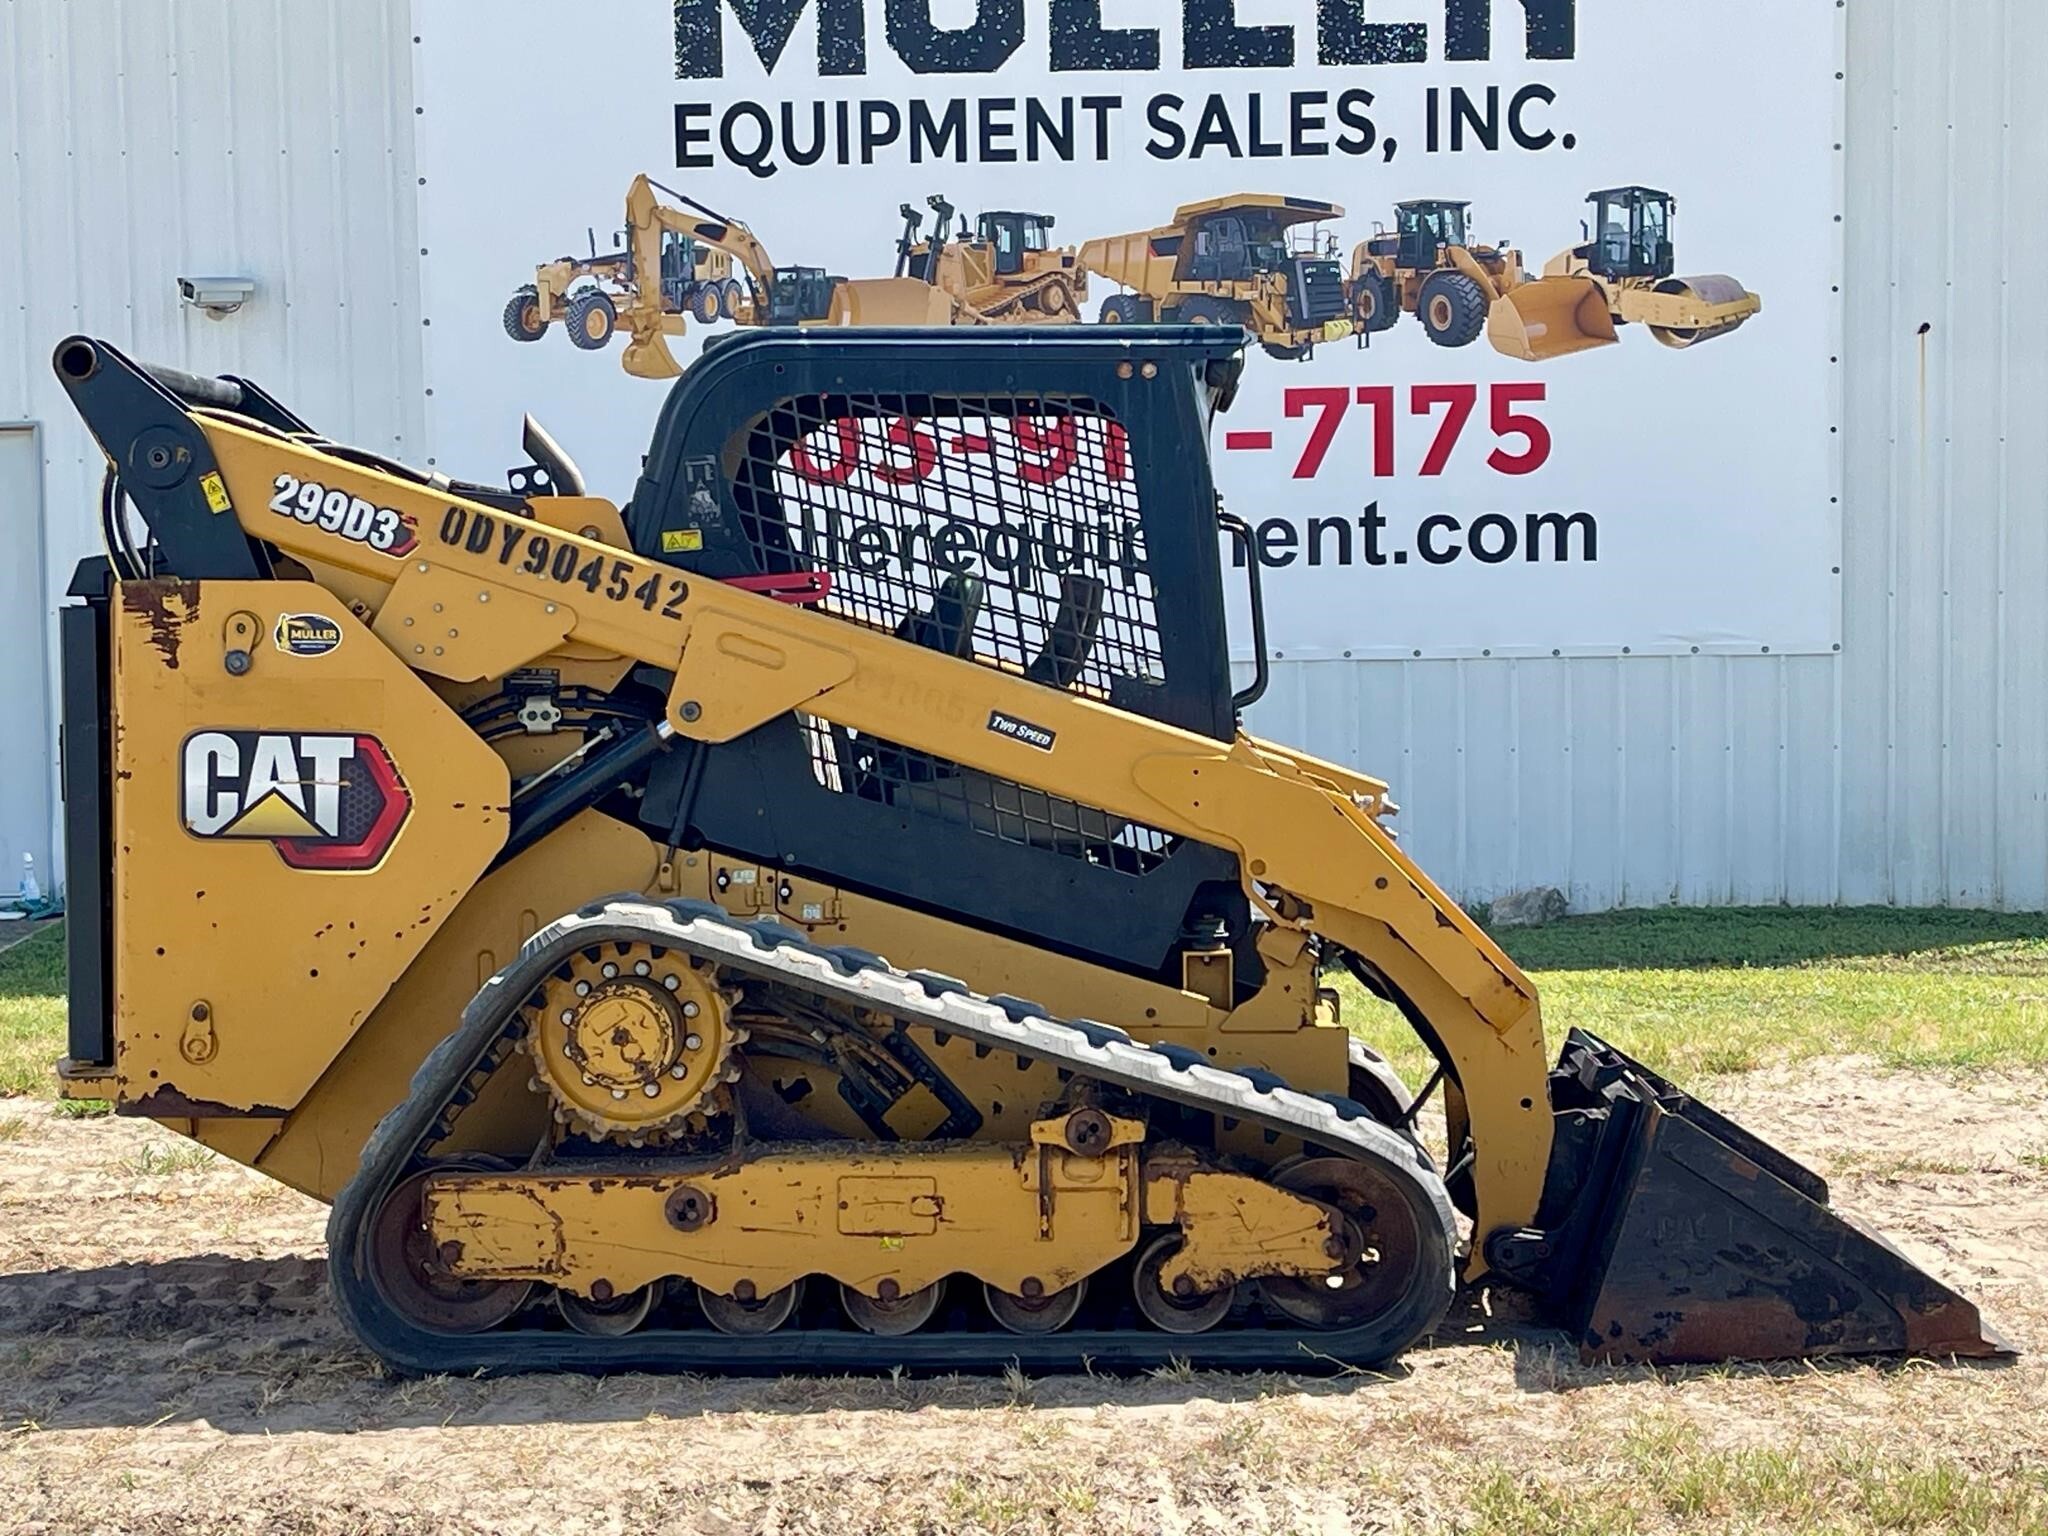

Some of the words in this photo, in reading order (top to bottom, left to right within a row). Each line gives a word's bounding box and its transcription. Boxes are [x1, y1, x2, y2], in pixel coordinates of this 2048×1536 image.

[673, 95, 1123, 180] EQUIPMENT
[1144, 87, 1397, 163] SALES,
[1425, 82, 1577, 153] INC.
[268, 473, 400, 550] 299D3
[290, 629, 337, 640] MULLER
[184, 732, 355, 838] CAT
